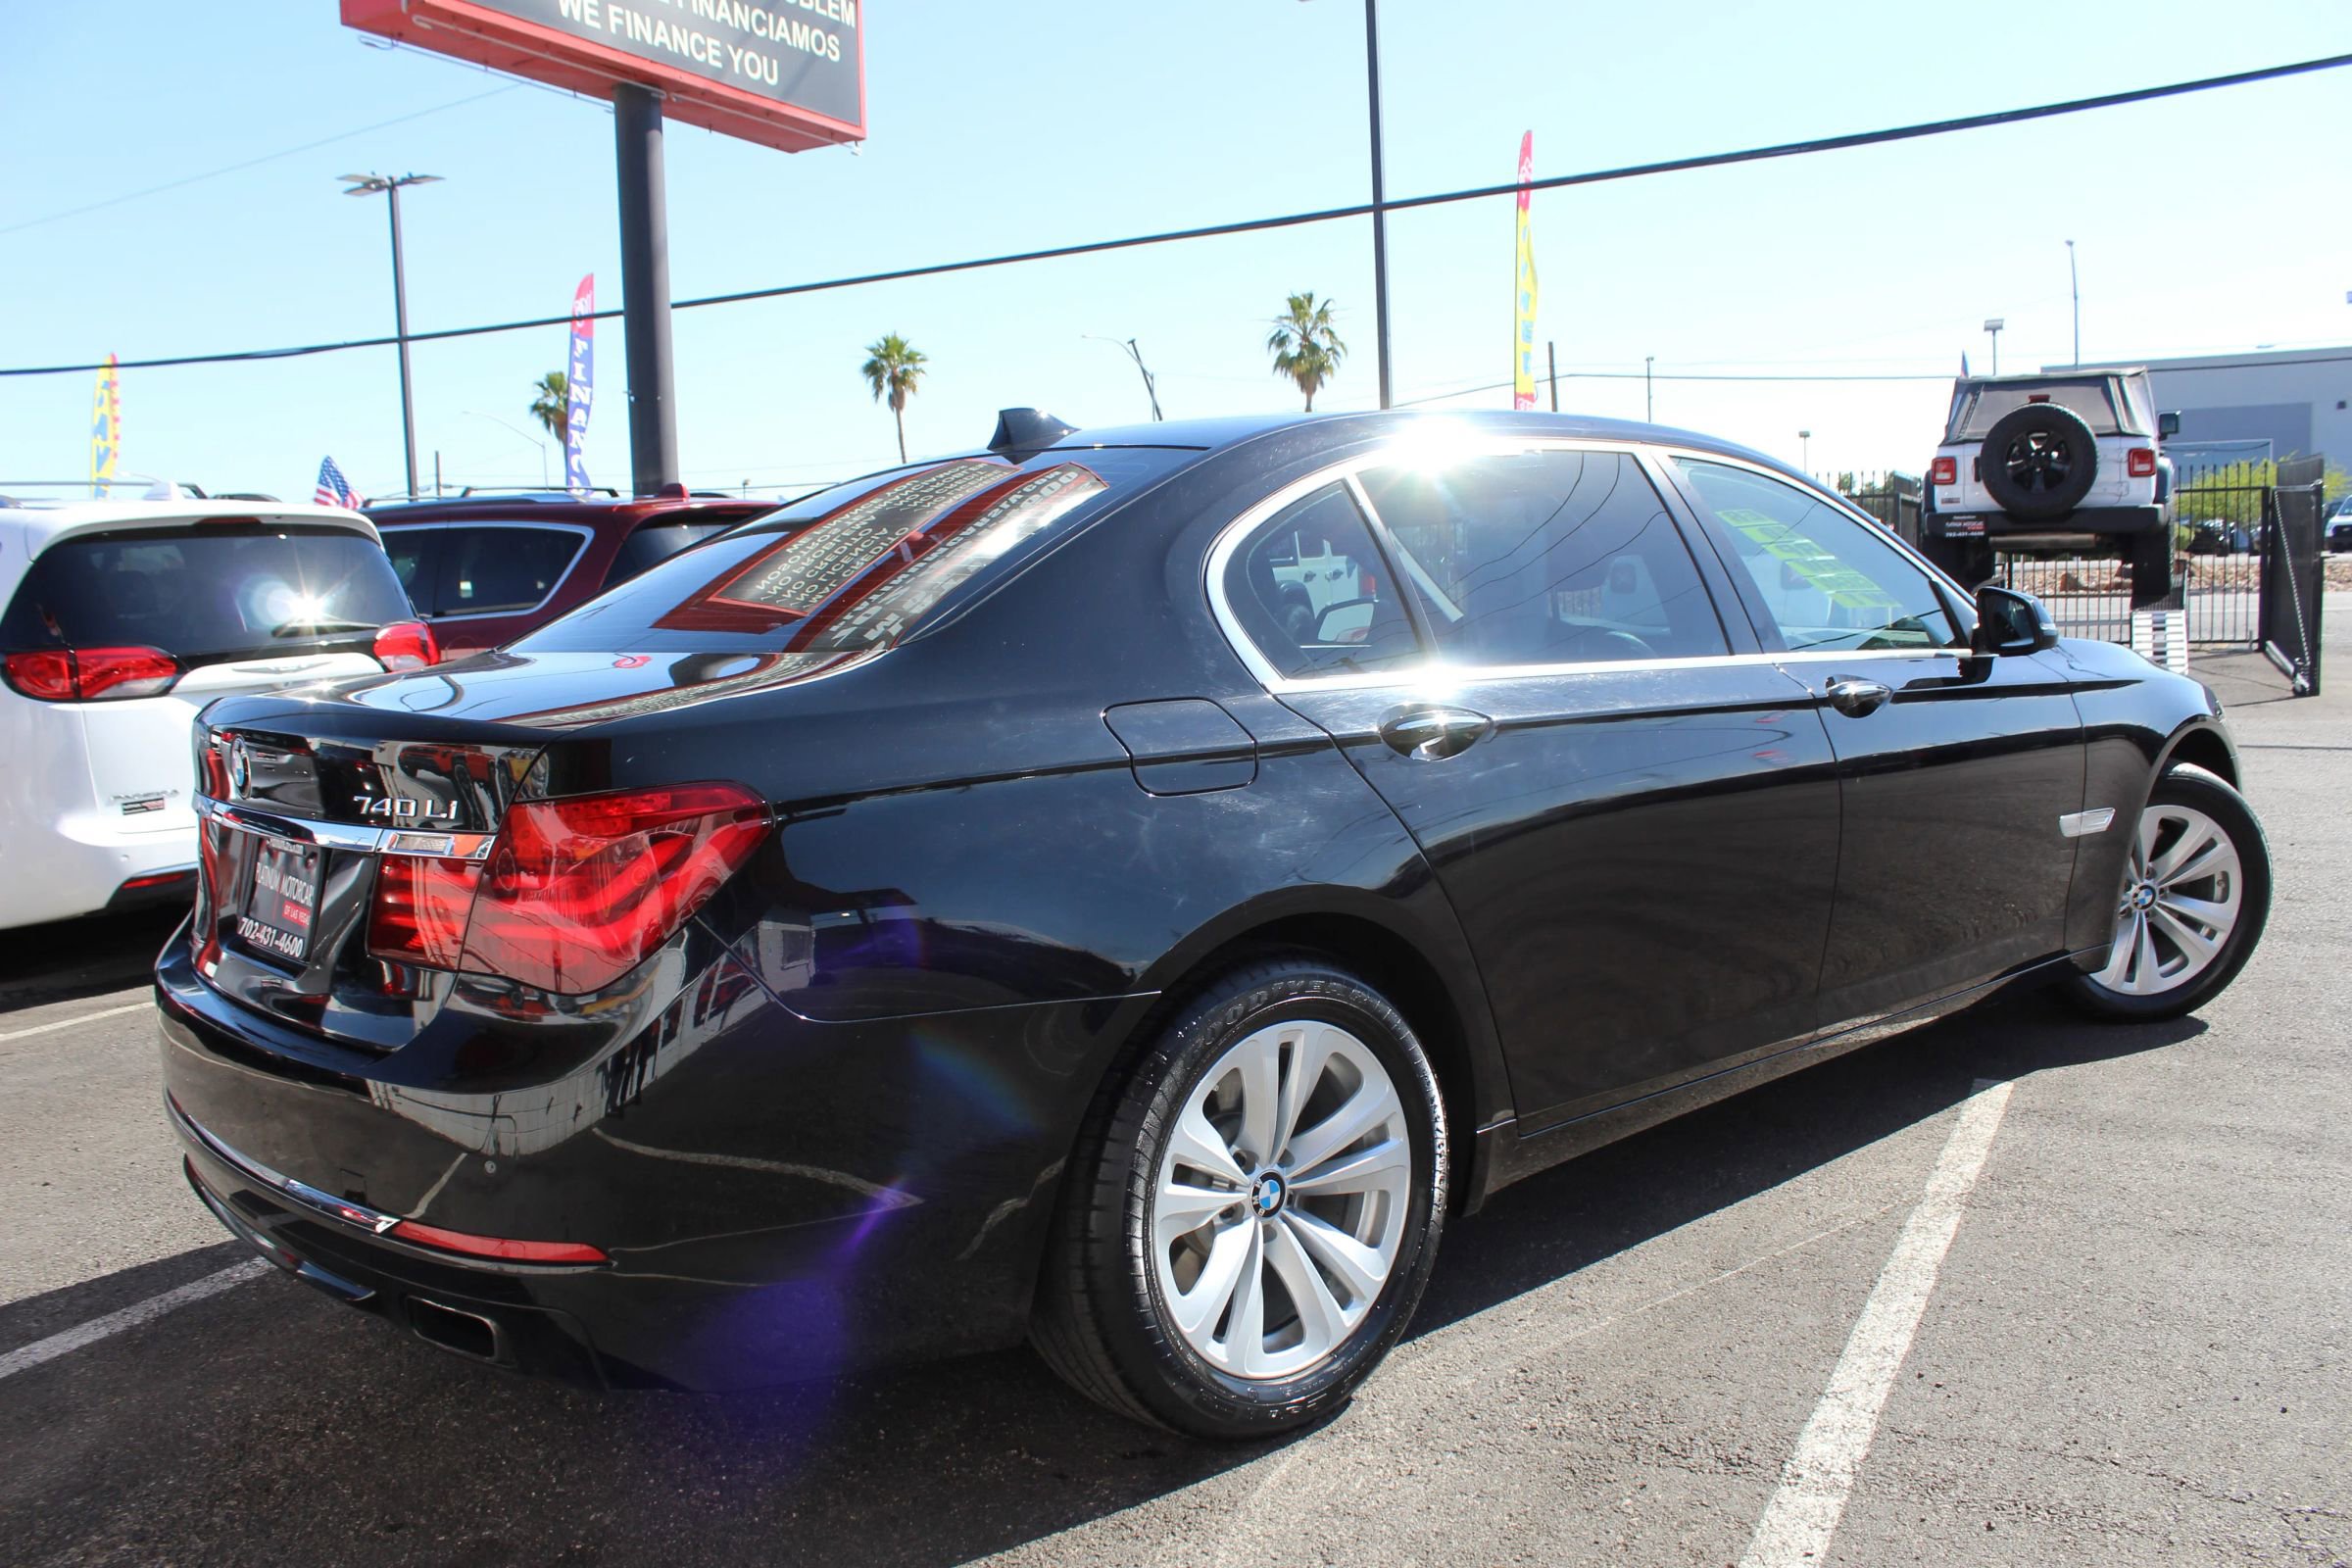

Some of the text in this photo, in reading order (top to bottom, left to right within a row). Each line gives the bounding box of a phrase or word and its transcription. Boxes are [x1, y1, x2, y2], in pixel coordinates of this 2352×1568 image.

[559, 0, 779, 86] WE FINANCE YOU
[238, 916, 304, 958] 702-431-4600
